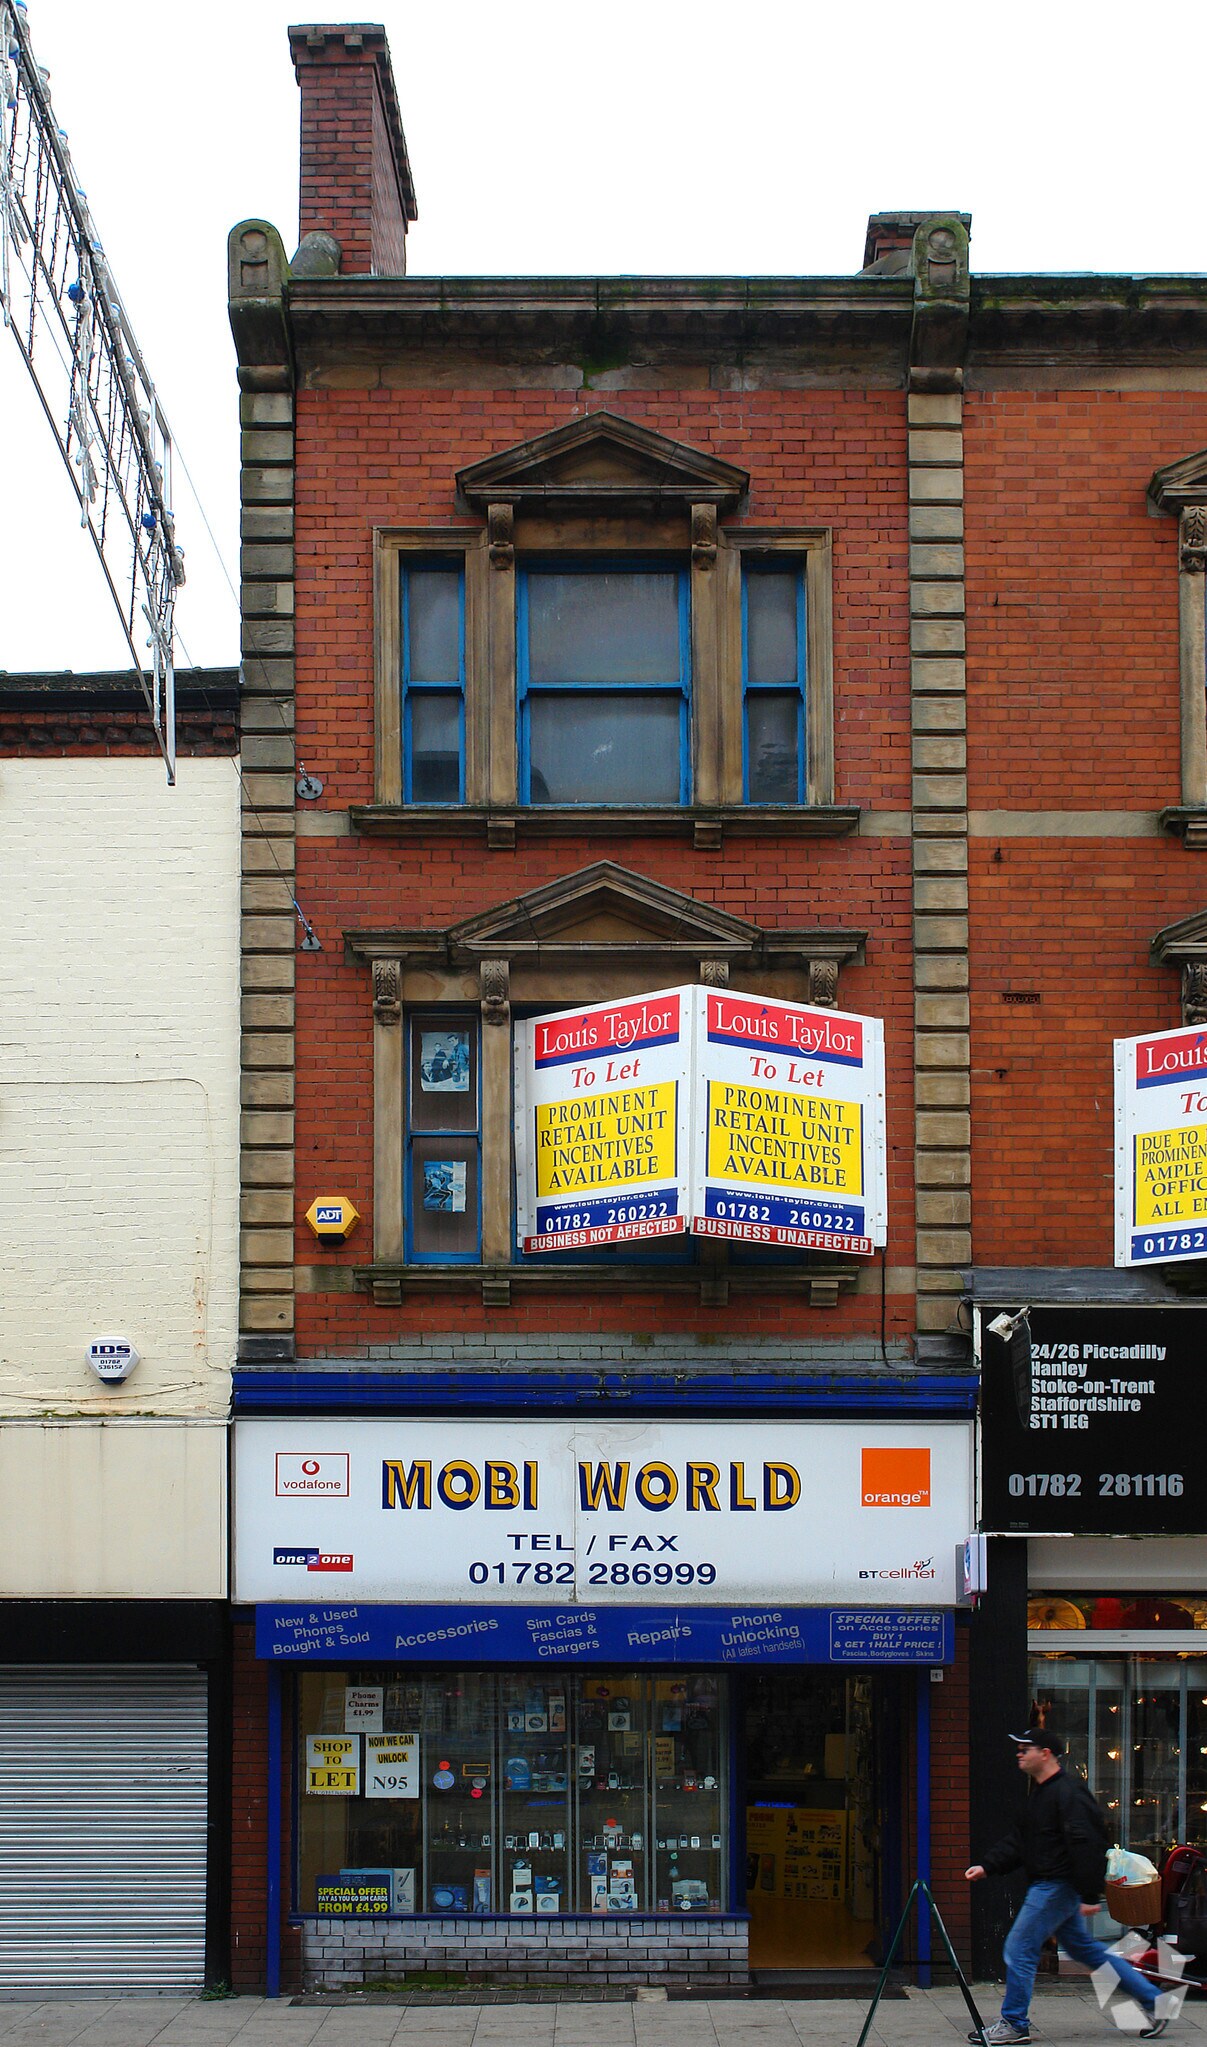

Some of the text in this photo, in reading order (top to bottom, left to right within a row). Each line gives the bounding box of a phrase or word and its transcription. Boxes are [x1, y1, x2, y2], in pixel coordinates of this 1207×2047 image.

[542, 1006, 672, 1054] Louis Taylor
[715, 1002, 855, 1054] Louis Taylor
[571, 1058, 641, 1088] To Let
[750, 1056, 825, 1087] To Let
[548, 1090, 658, 1125] PROMINENT
[725, 1087, 845, 1122] PROMINENT
[540, 1111, 667, 1148] RETAIL UNIT
[714, 1108, 854, 1145] RETAIL UNIT
[728, 1133, 841, 1165] INCENTIVES
[1142, 1130, 1199, 1151] DUE TO
[552, 1135, 654, 1167] INCENTIVES
[548, 1156, 658, 1189] AVAILABLE
[723, 1155, 846, 1187] AVAILABLE
[1144, 1162, 1203, 1182] AMPLE
[554, 1190, 659, 1211] www.louis-taylor.co.uk
[726, 1190, 844, 1210] www.louis-taylor.co.uk
[1151, 1201, 1184, 1217] ALL
[317, 1210, 342, 1220] ADT
[545, 1202, 668, 1232] 01782 260222
[716, 1201, 854, 1231] 01782 260222
[530, 1218, 677, 1250] BUSINESS NOT AFFECTED
[696, 1219, 869, 1252] BUSINESS UNAFFECTED
[1143, 1232, 1205, 1254] 01782
[92, 1345, 130, 1354] IDS
[1030, 1344, 1166, 1361] 24/26 Piccadilly
[1030, 1361, 1087, 1378] Hanley
[1031, 1379, 1155, 1394] Stoke-on-Trent
[1031, 1396, 1141, 1411] Staffordshire
[1029, 1414, 1089, 1429] ST1 1EG
[283, 1479, 341, 1490] vodafone
[381, 1459, 802, 1512] MOBI WORLD
[1008, 1473, 1184, 1496] 01782 281116
[507, 1534, 575, 1550] TEL
[609, 1534, 679, 1552] FAX
[468, 1562, 717, 1585] 01782 286999
[858, 1568, 936, 1579] BTcellnet
[274, 1608, 358, 1628] New & Used
[526, 1611, 597, 1630] Sim Cards
[731, 1611, 782, 1629] Phone
[836, 1615, 940, 1624] SPECIAL OFFER
[293, 1623, 344, 1639] Phones
[395, 1618, 499, 1649] Accessories
[532, 1624, 597, 1643] Fascias &
[627, 1625, 692, 1646] Repairs
[721, 1624, 800, 1646] Unlocking
[272, 1631, 370, 1655] Bought & Sold
[538, 1639, 600, 1657] Chargers
[738, 1645, 761, 1657] latest
[763, 1638, 805, 1653] handsets)
[313, 1743, 352, 1752] SHOP
[368, 1735, 414, 1747] NOW WE CAN
[378, 1753, 407, 1764] UNLOCK
[310, 1772, 356, 1787] LET
[372, 1776, 408, 1790] N95
[318, 1887, 387, 1896] SPECIAL OFFER
[318, 1902, 388, 1913] FROM £4.99
